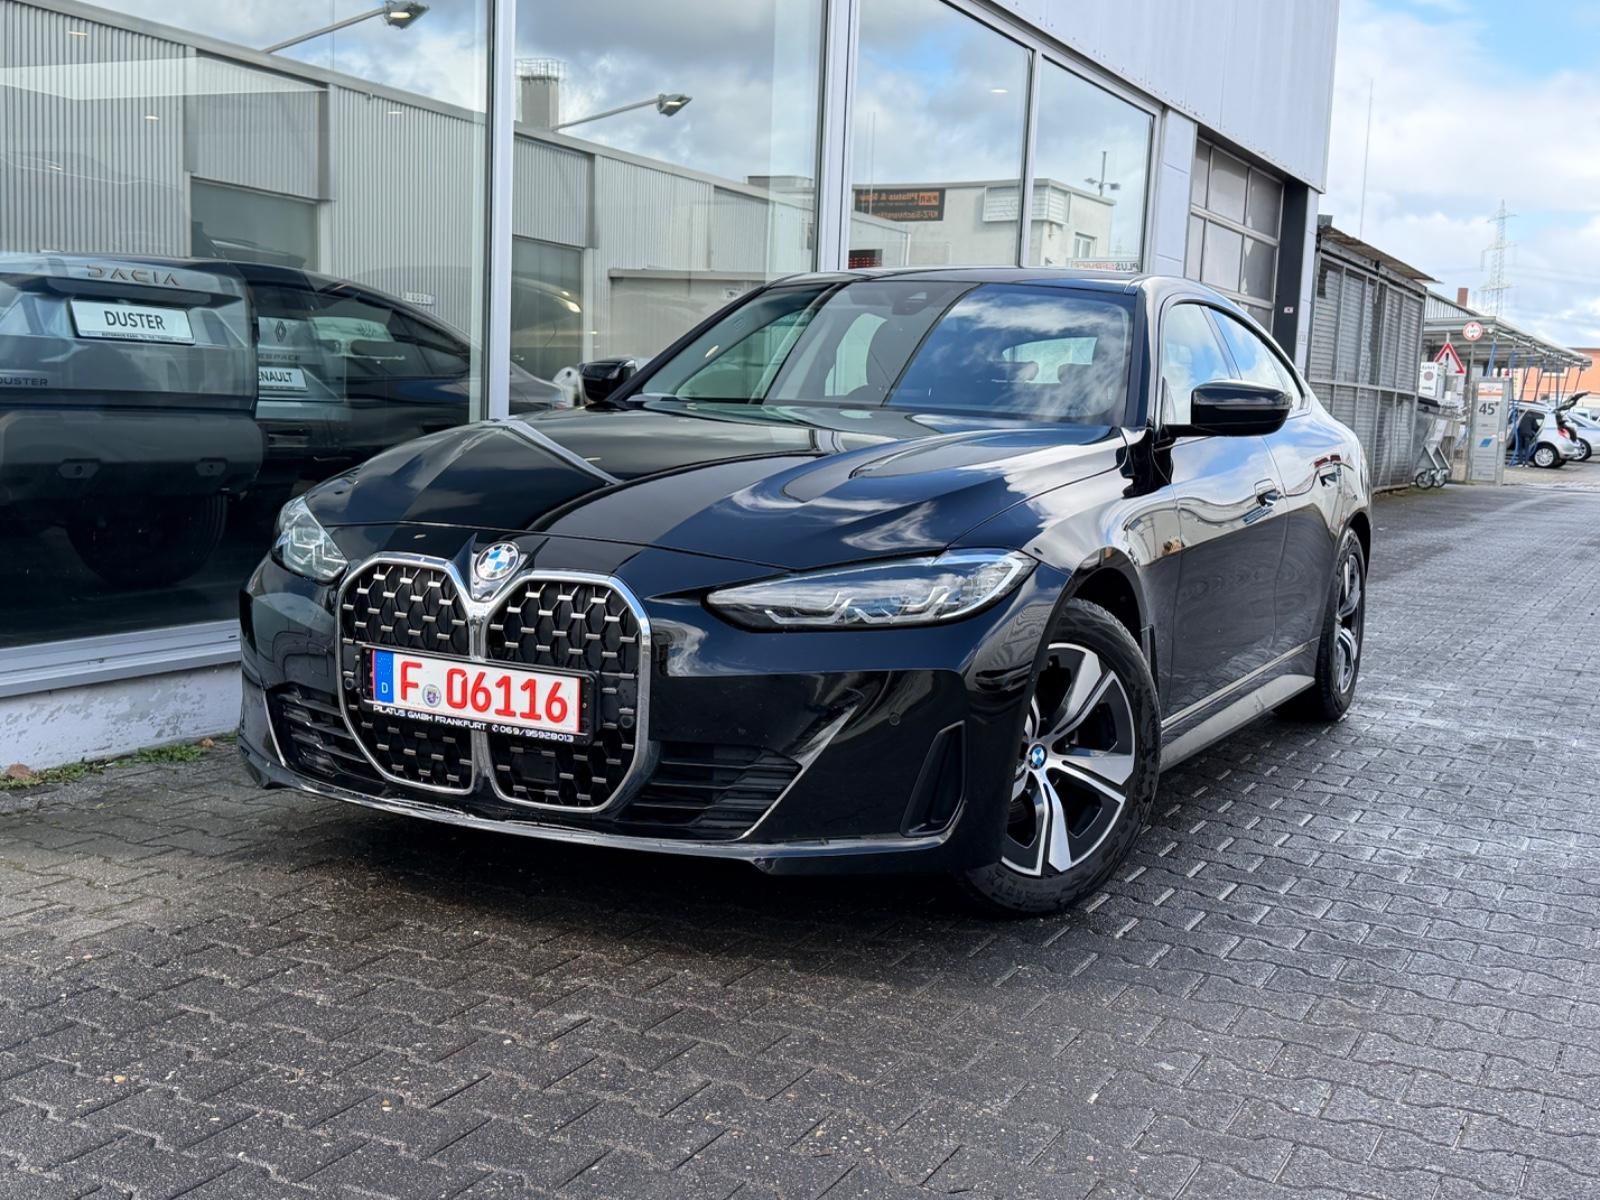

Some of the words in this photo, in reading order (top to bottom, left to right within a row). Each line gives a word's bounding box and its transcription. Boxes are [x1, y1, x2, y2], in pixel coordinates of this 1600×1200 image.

[86, 264, 180, 287] DACIA
[104, 310, 166, 330] DUSTER
[381, 682, 389, 694] D
[400, 661, 422, 700] F
[446, 668, 567, 723] 06116
[373, 704, 406, 718] PILATUS
[435, 715, 487, 731] FRANKFURT
